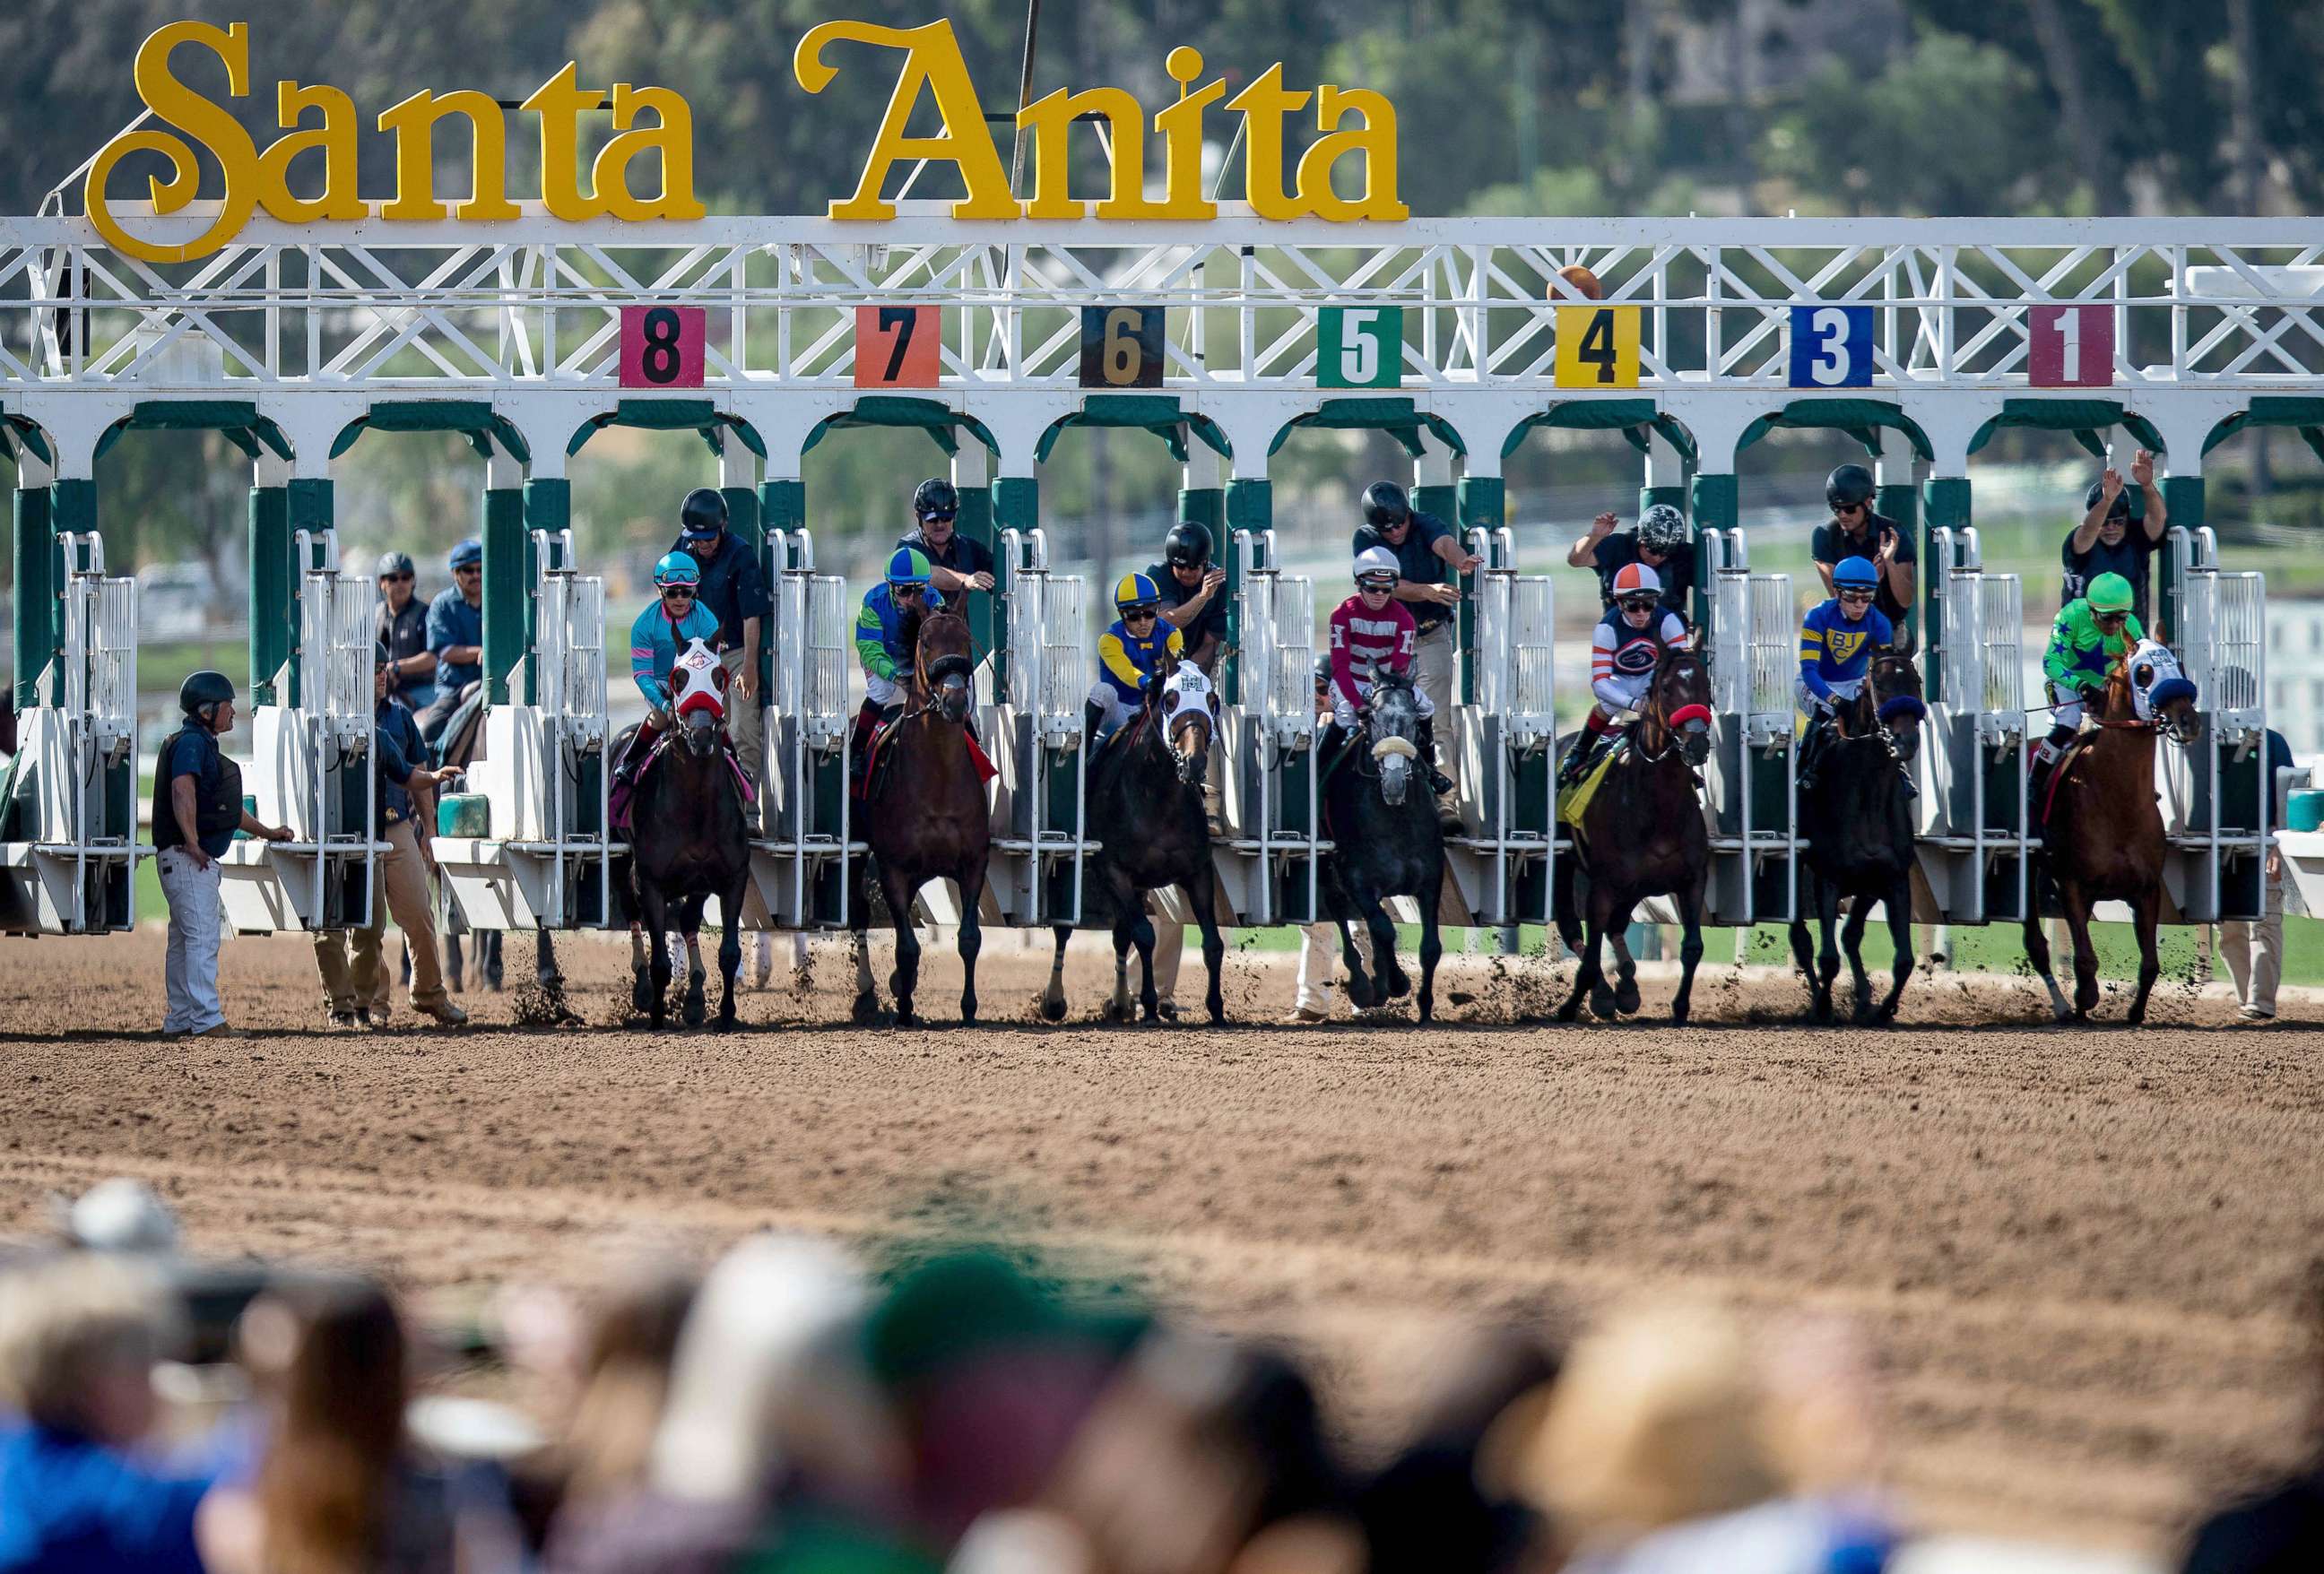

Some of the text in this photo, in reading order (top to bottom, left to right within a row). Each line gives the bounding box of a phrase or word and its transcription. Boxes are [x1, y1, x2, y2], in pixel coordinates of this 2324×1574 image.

[85, 18, 1410, 263] Santa Anita
[642, 307, 681, 385] 8
[879, 307, 916, 382] 7
[1103, 307, 1143, 385] 6
[1340, 308, 1380, 384] 5
[1578, 308, 1617, 384] 4
[1811, 307, 1851, 385] 3
[2053, 307, 2080, 382] 1
